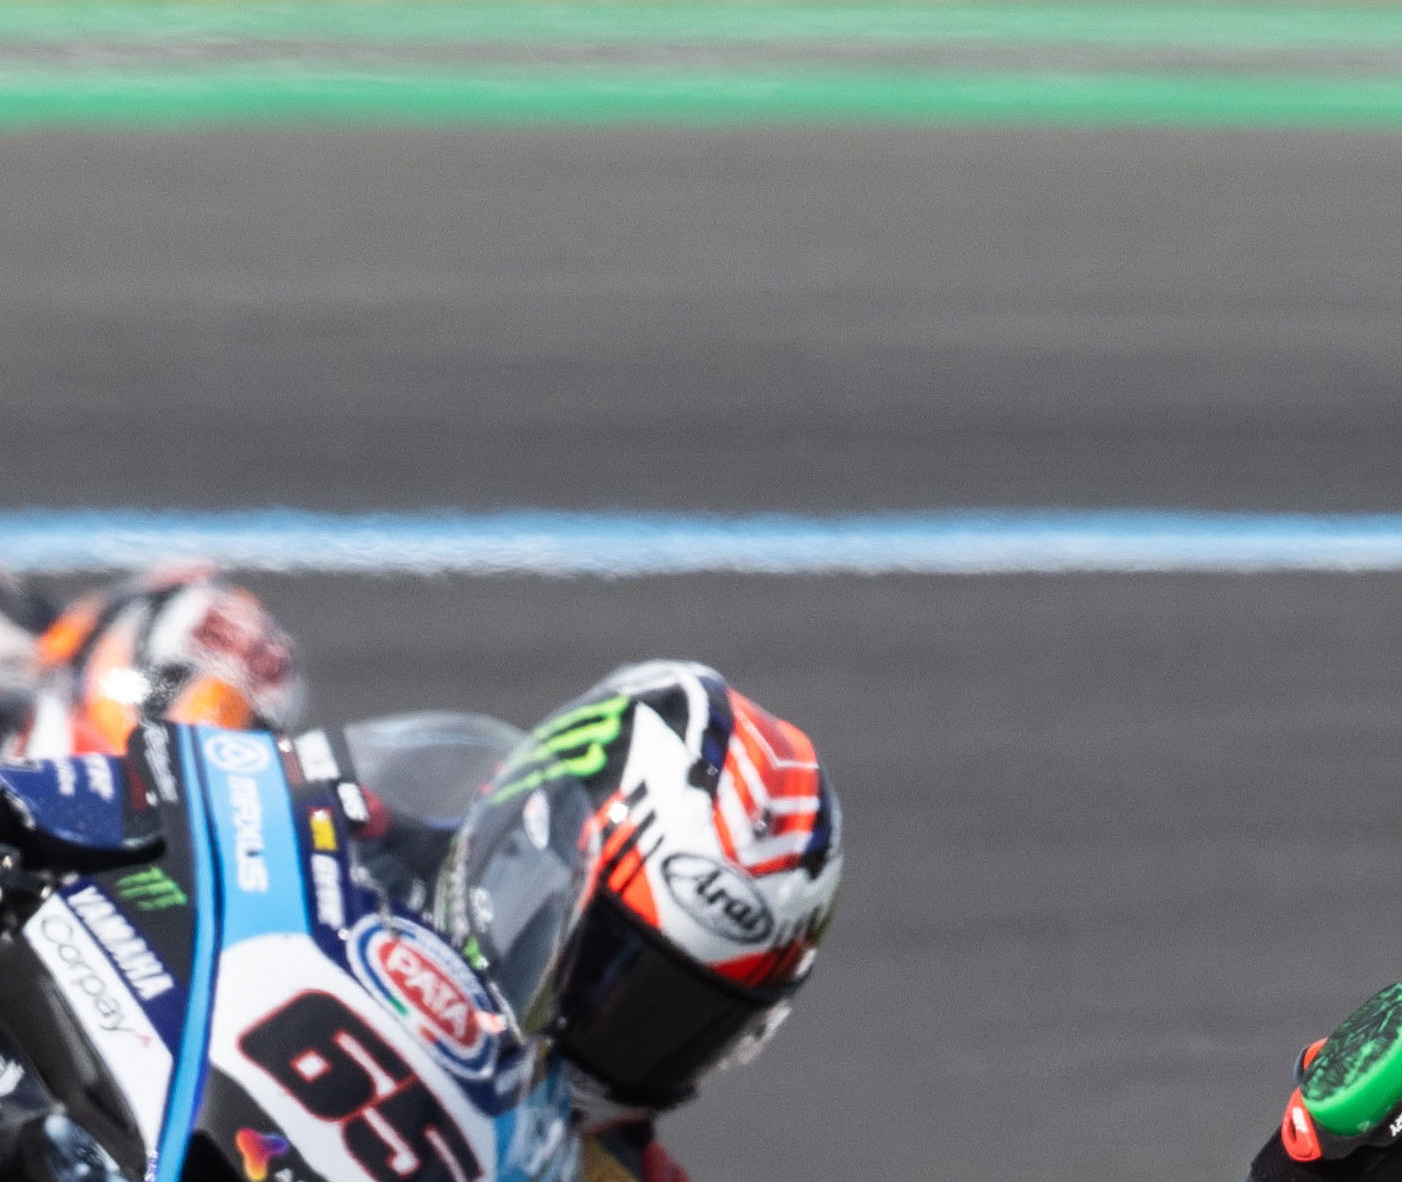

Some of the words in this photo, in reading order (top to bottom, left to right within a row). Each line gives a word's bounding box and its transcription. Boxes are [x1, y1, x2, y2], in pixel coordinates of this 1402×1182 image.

[67, 885, 175, 1001] YAMAHA
[680, 866, 767, 942] Arai
[41, 914, 139, 1033] Corpay
[385, 947, 469, 1039] PATA
